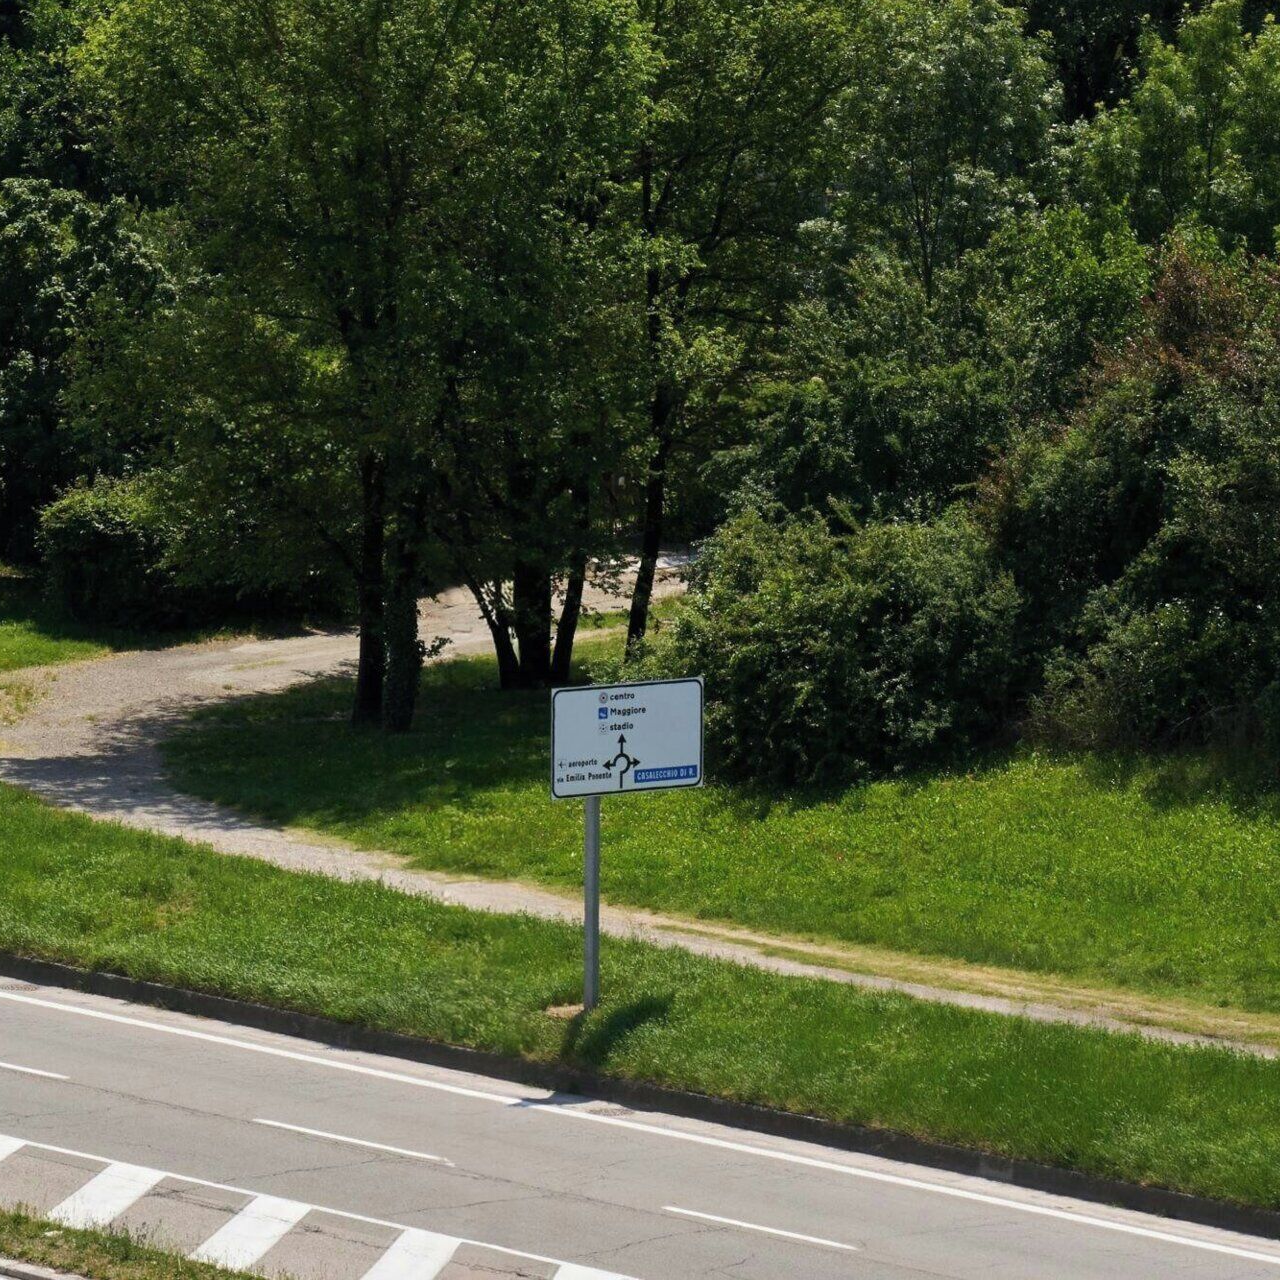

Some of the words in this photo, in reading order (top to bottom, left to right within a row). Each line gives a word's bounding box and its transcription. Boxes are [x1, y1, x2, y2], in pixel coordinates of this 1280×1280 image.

[610, 707, 646, 716] Maggiore
[610, 722, 634, 731] stadio
[568, 759, 598, 768] aeroporto
[566, 774, 585, 782] Emilia
[588, 772, 612, 780] Ponente
[636, 770, 678, 780] CASALECCHIO
[680, 768, 687, 777] DI
